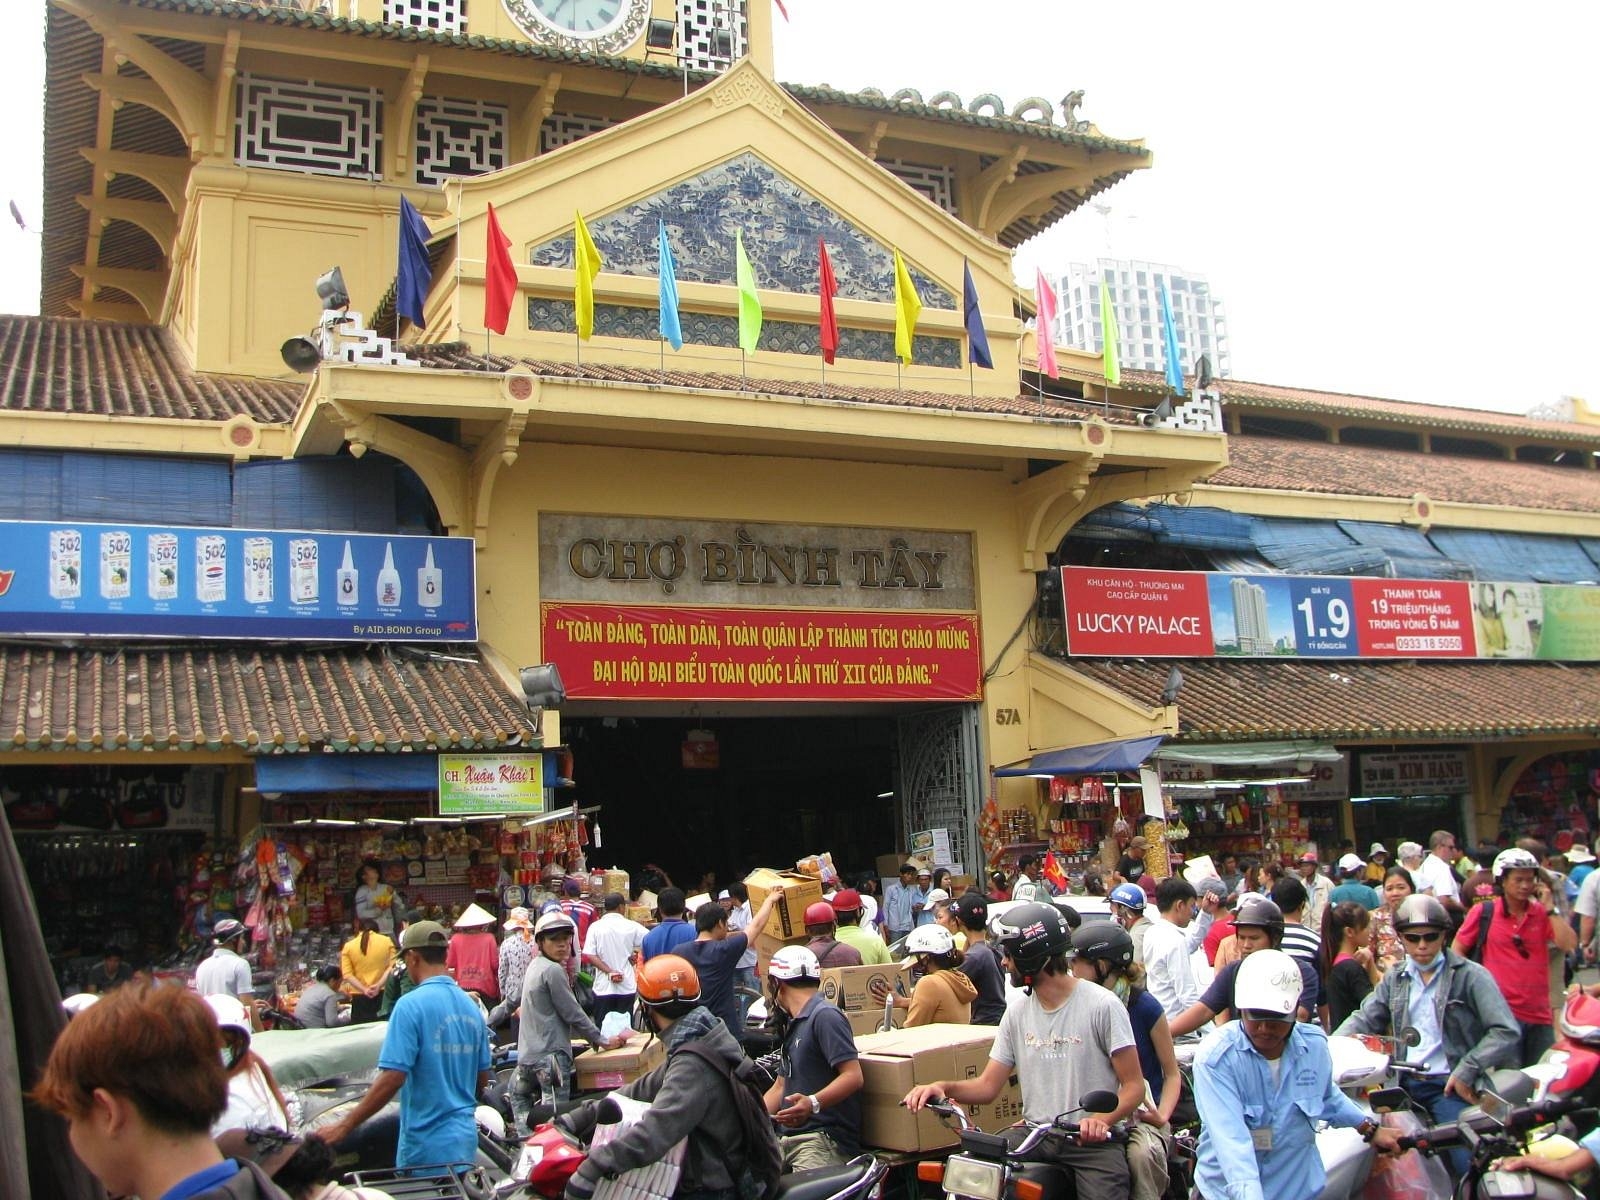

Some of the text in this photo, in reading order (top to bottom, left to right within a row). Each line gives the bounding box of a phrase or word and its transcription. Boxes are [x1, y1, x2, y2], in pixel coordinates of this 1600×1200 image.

[568, 528, 948, 594] CHỢ BÌNH TÂY
[1087, 579, 1103, 587] KHU
[1106, 591, 1122, 599] CAO
[1382, 589, 1414, 599] THANH
[1371, 599, 1389, 614] 19
[1077, 612, 1201, 636] LUCKY PALACE
[1297, 597, 1350, 639] 1.9
[1368, 619, 1400, 630] TRONG
[1402, 617, 1428, 630] VÒNG
[1429, 614, 1438, 630] 6
[353, 625, 365, 635] By
[415, 626, 442, 636] Group
[607, 614, 647, 648] ĐẢNG,
[651, 618, 686, 645] TOÀN
[690, 619, 721, 650] DÂN,
[724, 620, 758, 646] TOÀN
[762, 622, 796, 650] QUÂN
[800, 622, 824, 651] LẬP
[827, 623, 868, 648] THÀNH
[871, 624, 898, 648] TÍCH
[901, 624, 933, 649] CHÀO
[936, 626, 970, 650] MỪNG
[1398, 638, 1421, 649] 0933
[1438, 638, 1461, 649] 5050
[593, 660, 617, 687] ĐẠI
[621, 655, 644, 687] HỘI
[648, 661, 671, 687] ĐẠI
[675, 651, 707, 684] BIỂU
[710, 657, 745, 684] TOÀN
[748, 655, 782, 686] QUỐC
[786, 655, 811, 684] LẦN
[814, 658, 839, 684] THỨ
[843, 664, 866, 684] XII
[869, 656, 893, 684] CỦA
[995, 708, 1022, 726] 57A
